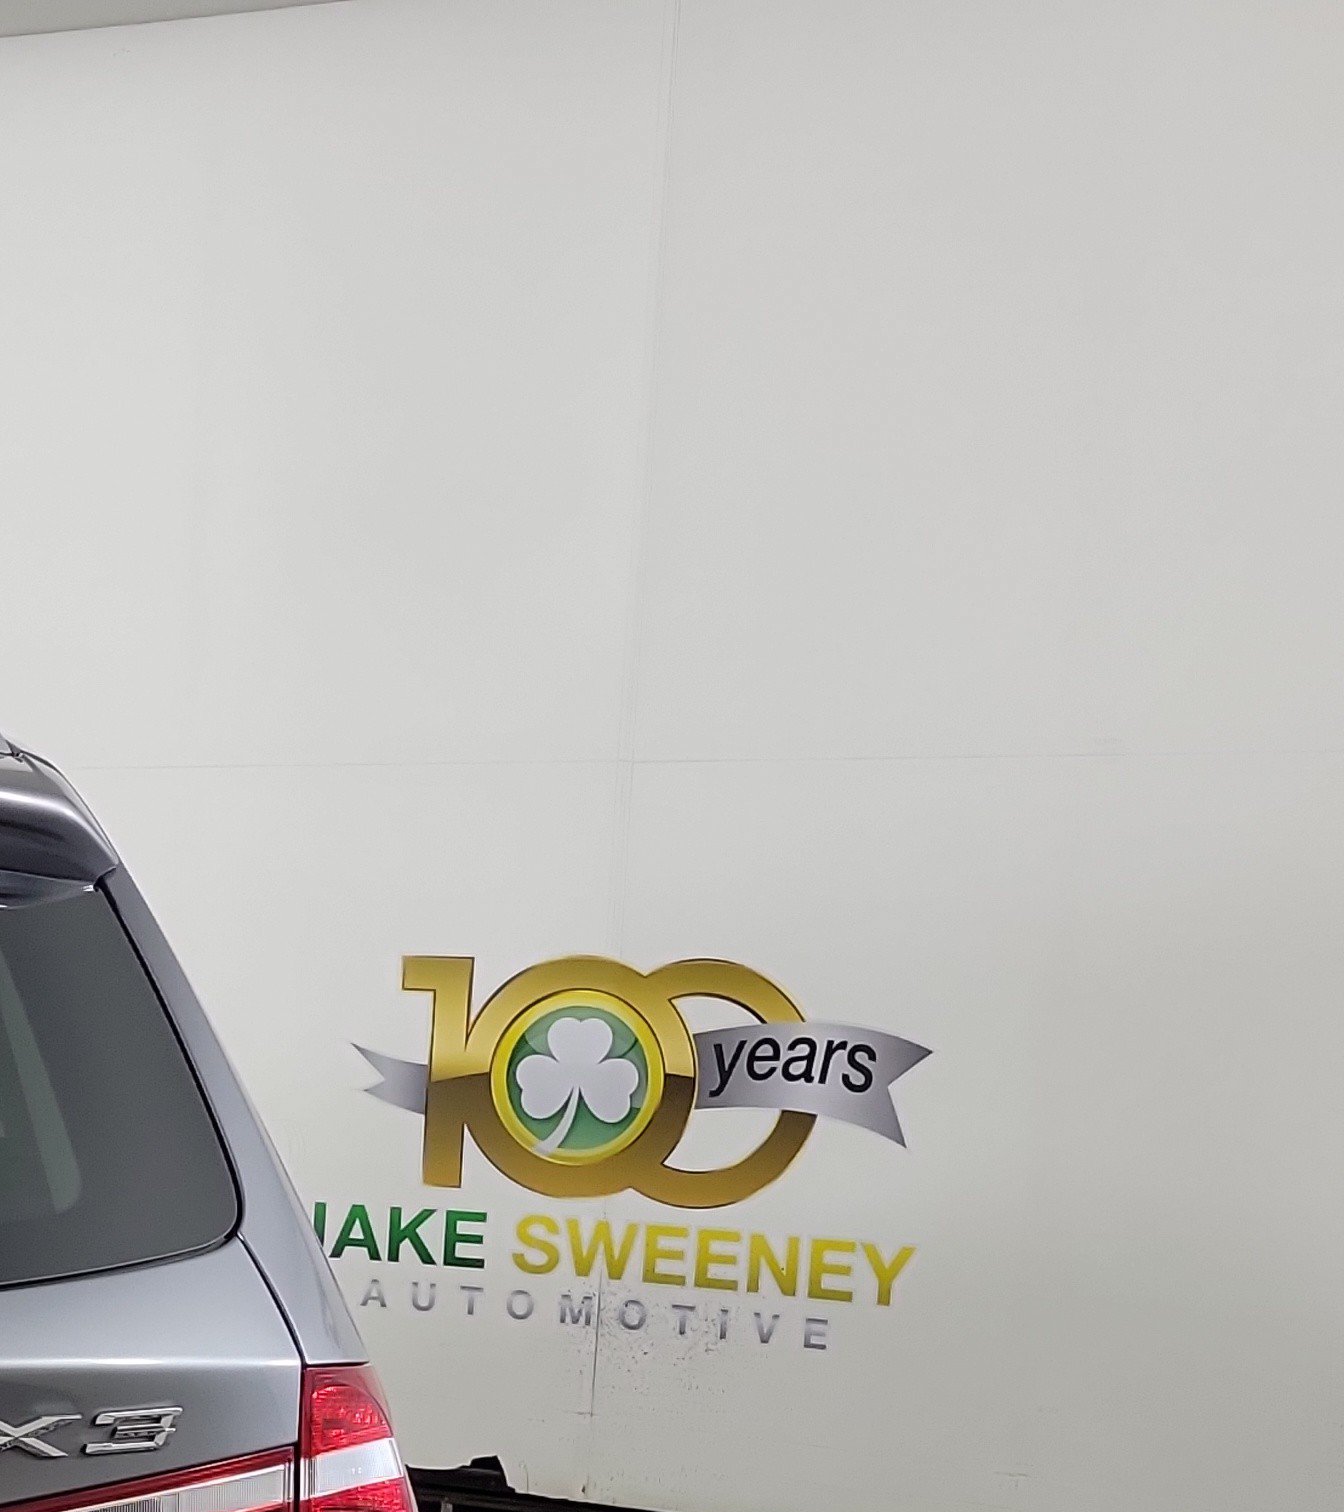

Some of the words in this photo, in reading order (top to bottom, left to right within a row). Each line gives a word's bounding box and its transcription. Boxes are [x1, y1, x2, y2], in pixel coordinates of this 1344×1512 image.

[402, 954, 818, 1209] 100
[708, 1035, 878, 1098] years
[511, 1213, 917, 1308] SWEENEY
[359, 1278, 831, 1351] AUTOMOTIVE
